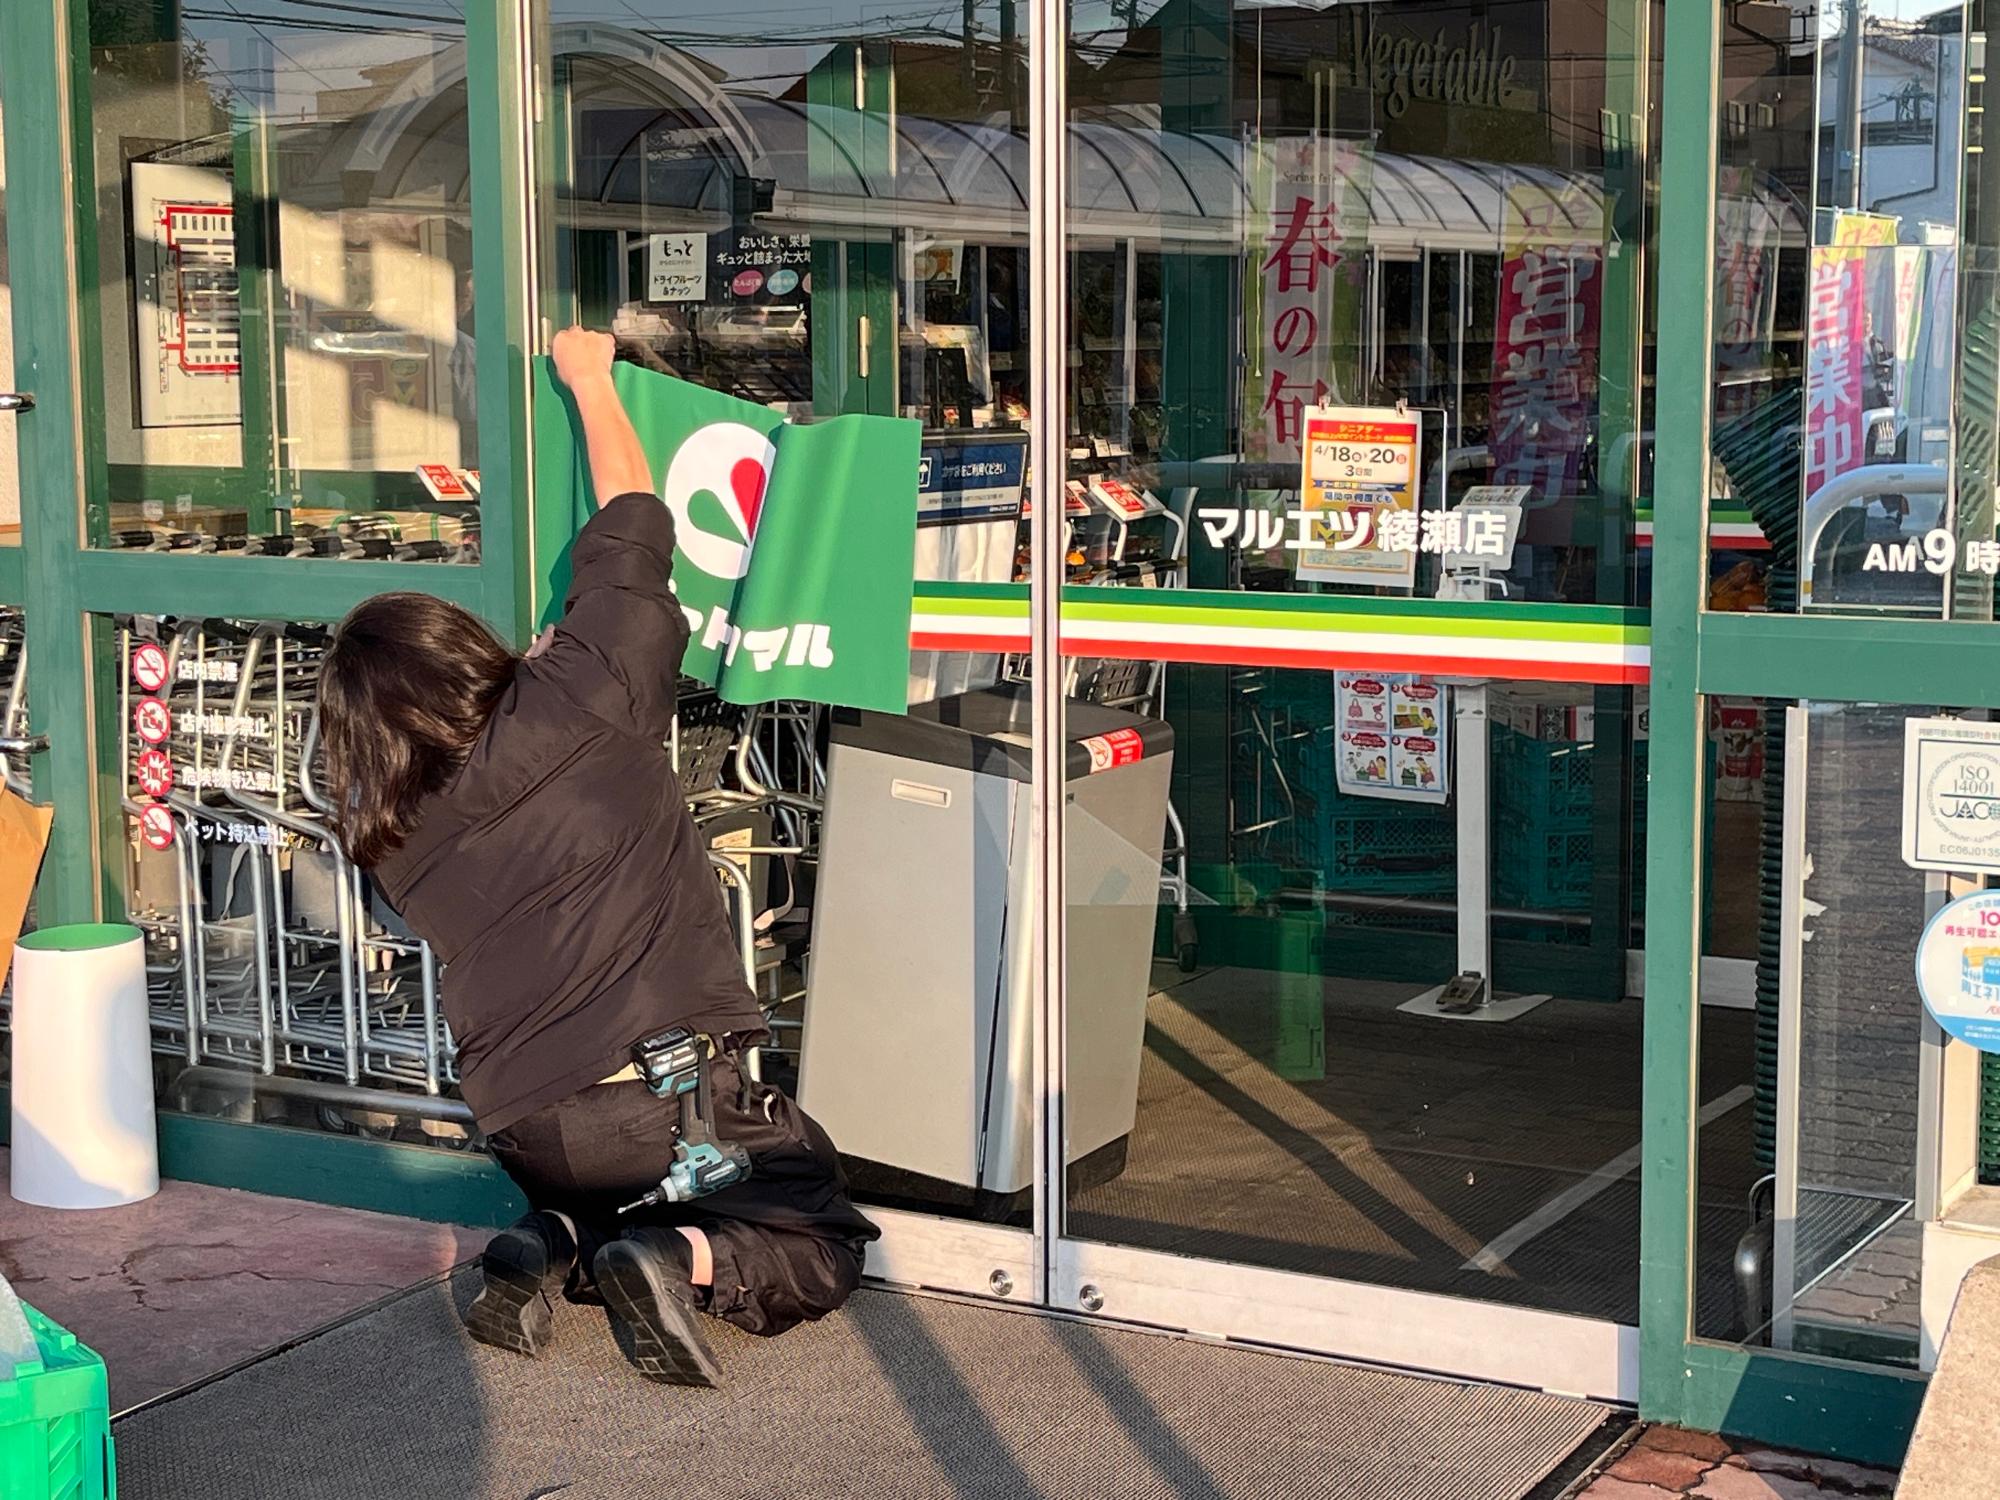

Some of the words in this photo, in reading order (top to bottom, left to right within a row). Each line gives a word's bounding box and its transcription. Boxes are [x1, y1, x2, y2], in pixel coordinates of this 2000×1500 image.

[1351, 5, 1516, 119] Vegetable
[663, 239, 694, 257] もっと
[653, 274, 702, 285] ドライフルーツ
[1808, 259, 1852, 492] 営業中
[177, 659, 239, 682] 店内禁煙
[179, 712, 273, 738] 店内撮影禁止
[181, 765, 288, 793] 危険物持込禁止
[1960, 765, 1990, 781] ISO
[1953, 779, 1995, 796] 14001
[184, 820, 290, 847] ペット持込禁止
[1945, 925, 2000, 940] 再生可能エ
